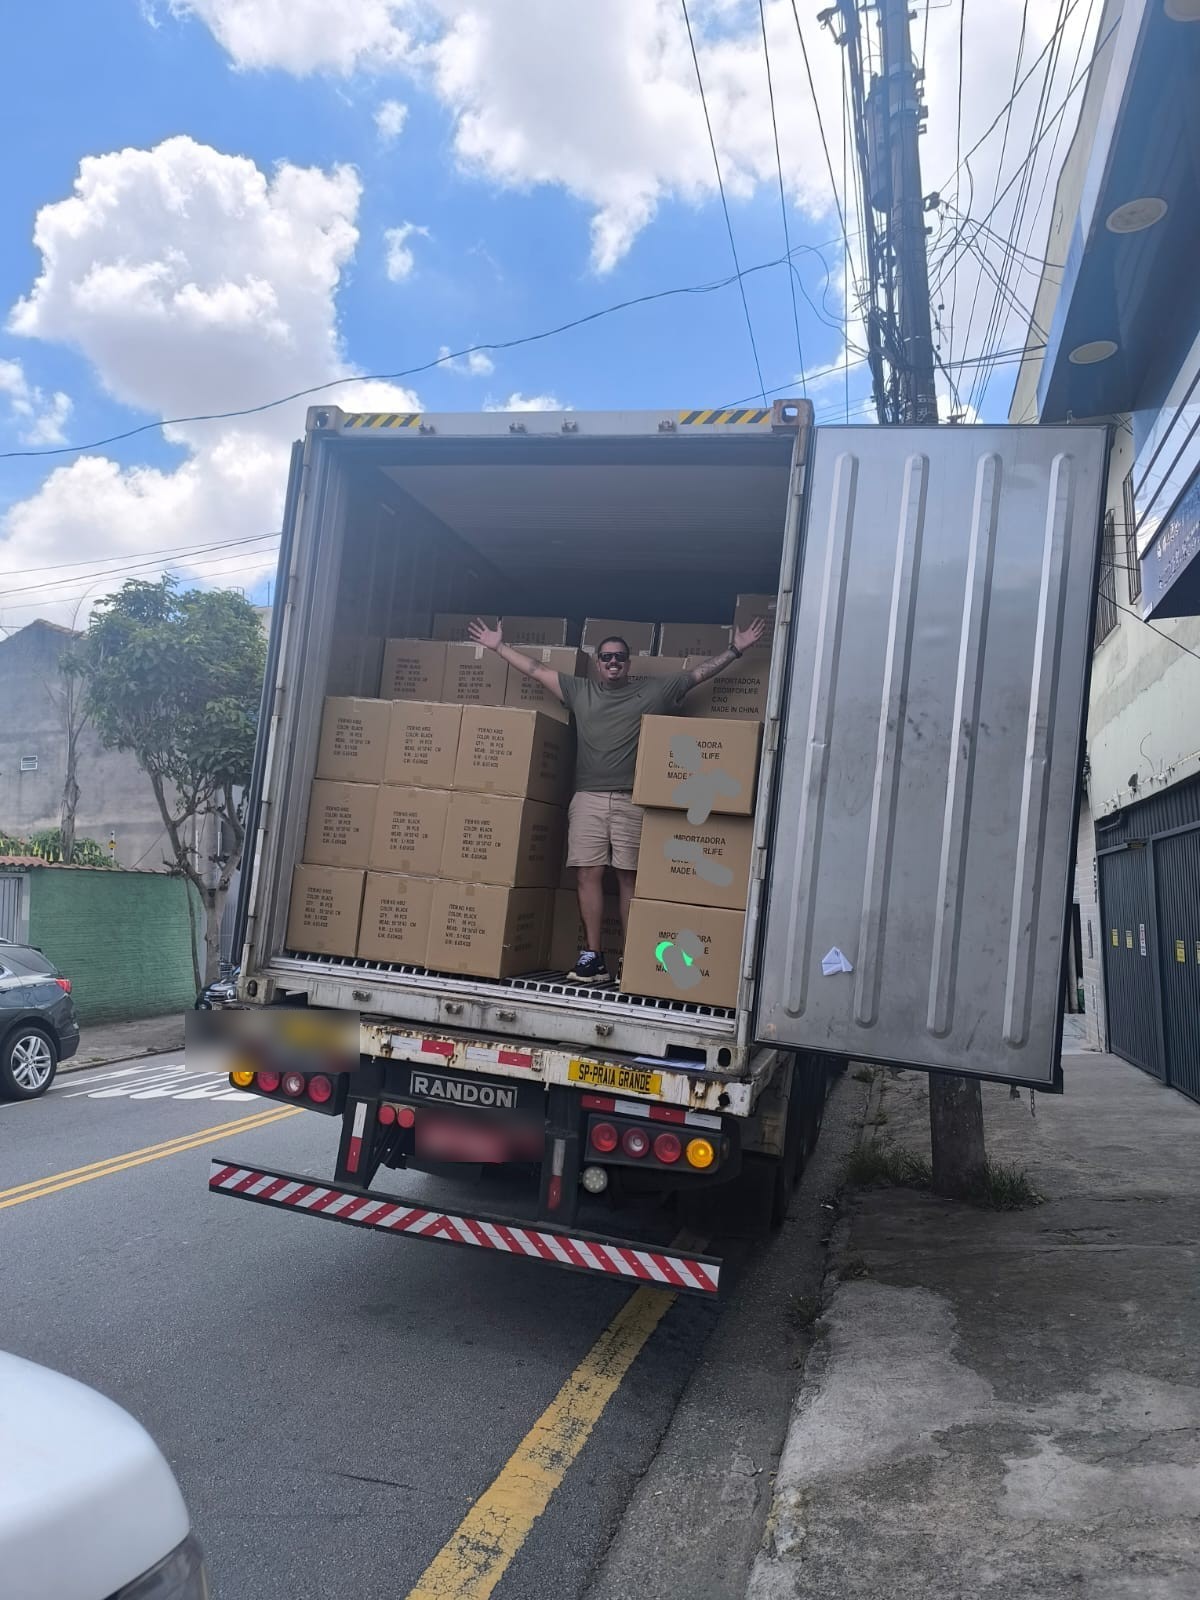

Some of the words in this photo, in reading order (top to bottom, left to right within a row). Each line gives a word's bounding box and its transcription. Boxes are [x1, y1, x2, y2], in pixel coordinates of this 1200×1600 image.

[667, 771, 688, 780] MADE
[673, 834, 726, 845] IMPORTADORA
[670, 866, 691, 875] MADE
[579, 1064, 616, 1086] SP-PRAIA
[618, 1071, 652, 1092] GRANDE
[414, 1076, 513, 1109] RANDON
